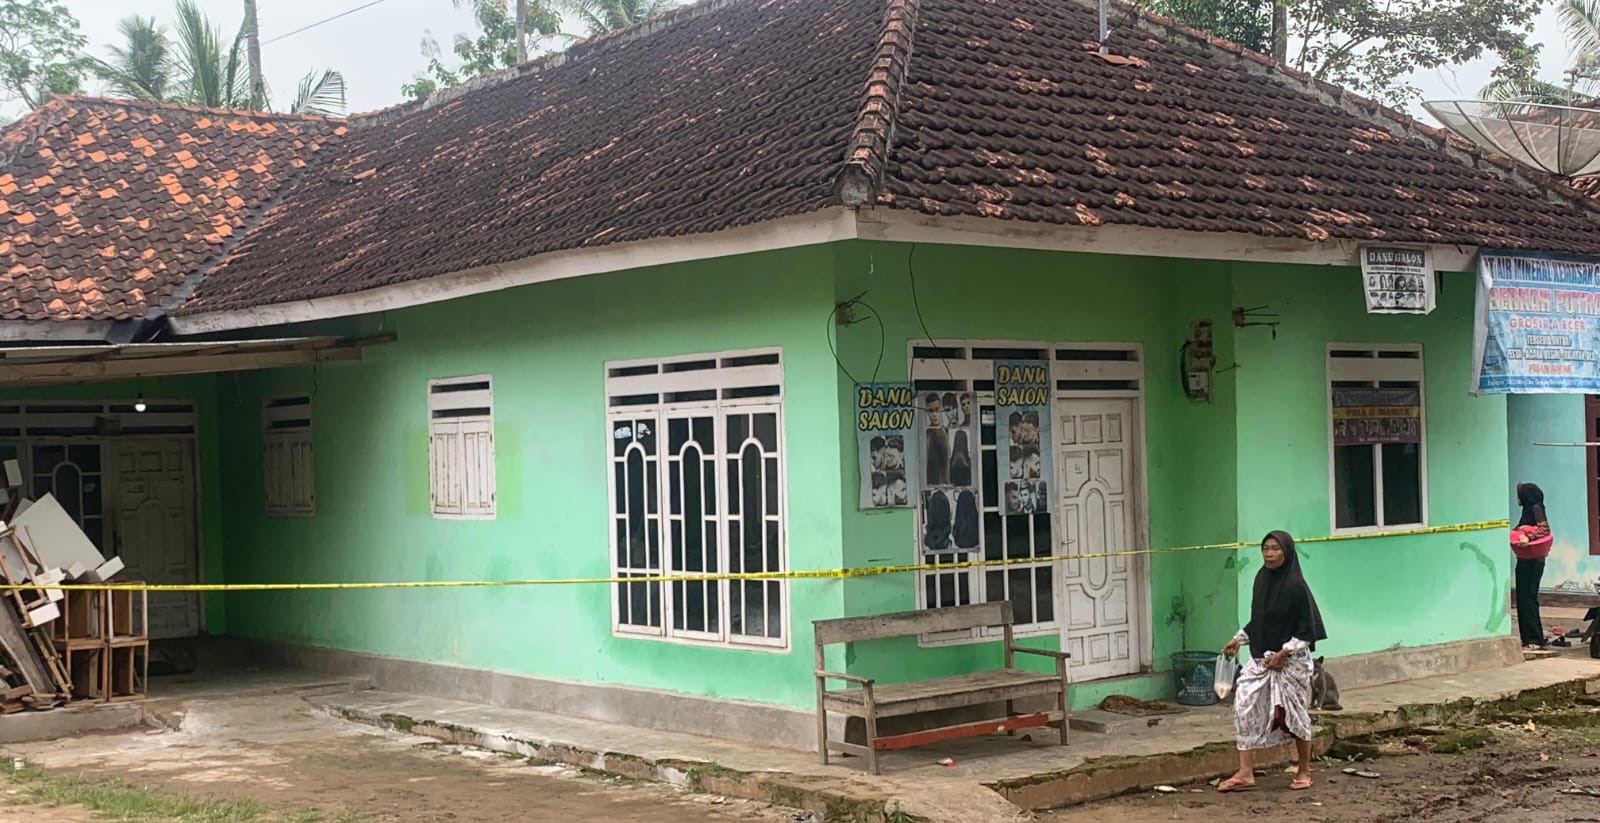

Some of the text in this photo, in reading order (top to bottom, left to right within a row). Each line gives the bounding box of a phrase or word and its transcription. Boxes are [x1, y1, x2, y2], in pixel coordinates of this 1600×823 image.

[1370, 252, 1393, 263] DANU
[1497, 257, 1512, 280] AIR
[1513, 258, 1551, 281] MINERAL
[1488, 287, 1551, 312] BERKAH
[1510, 318, 1549, 329] GROSIR
[1562, 320, 1585, 331] ECER
[998, 366, 1046, 385] DANU
[859, 387, 913, 409] DANU
[997, 388, 1048, 407] SALON
[858, 409, 914, 431] SALON
